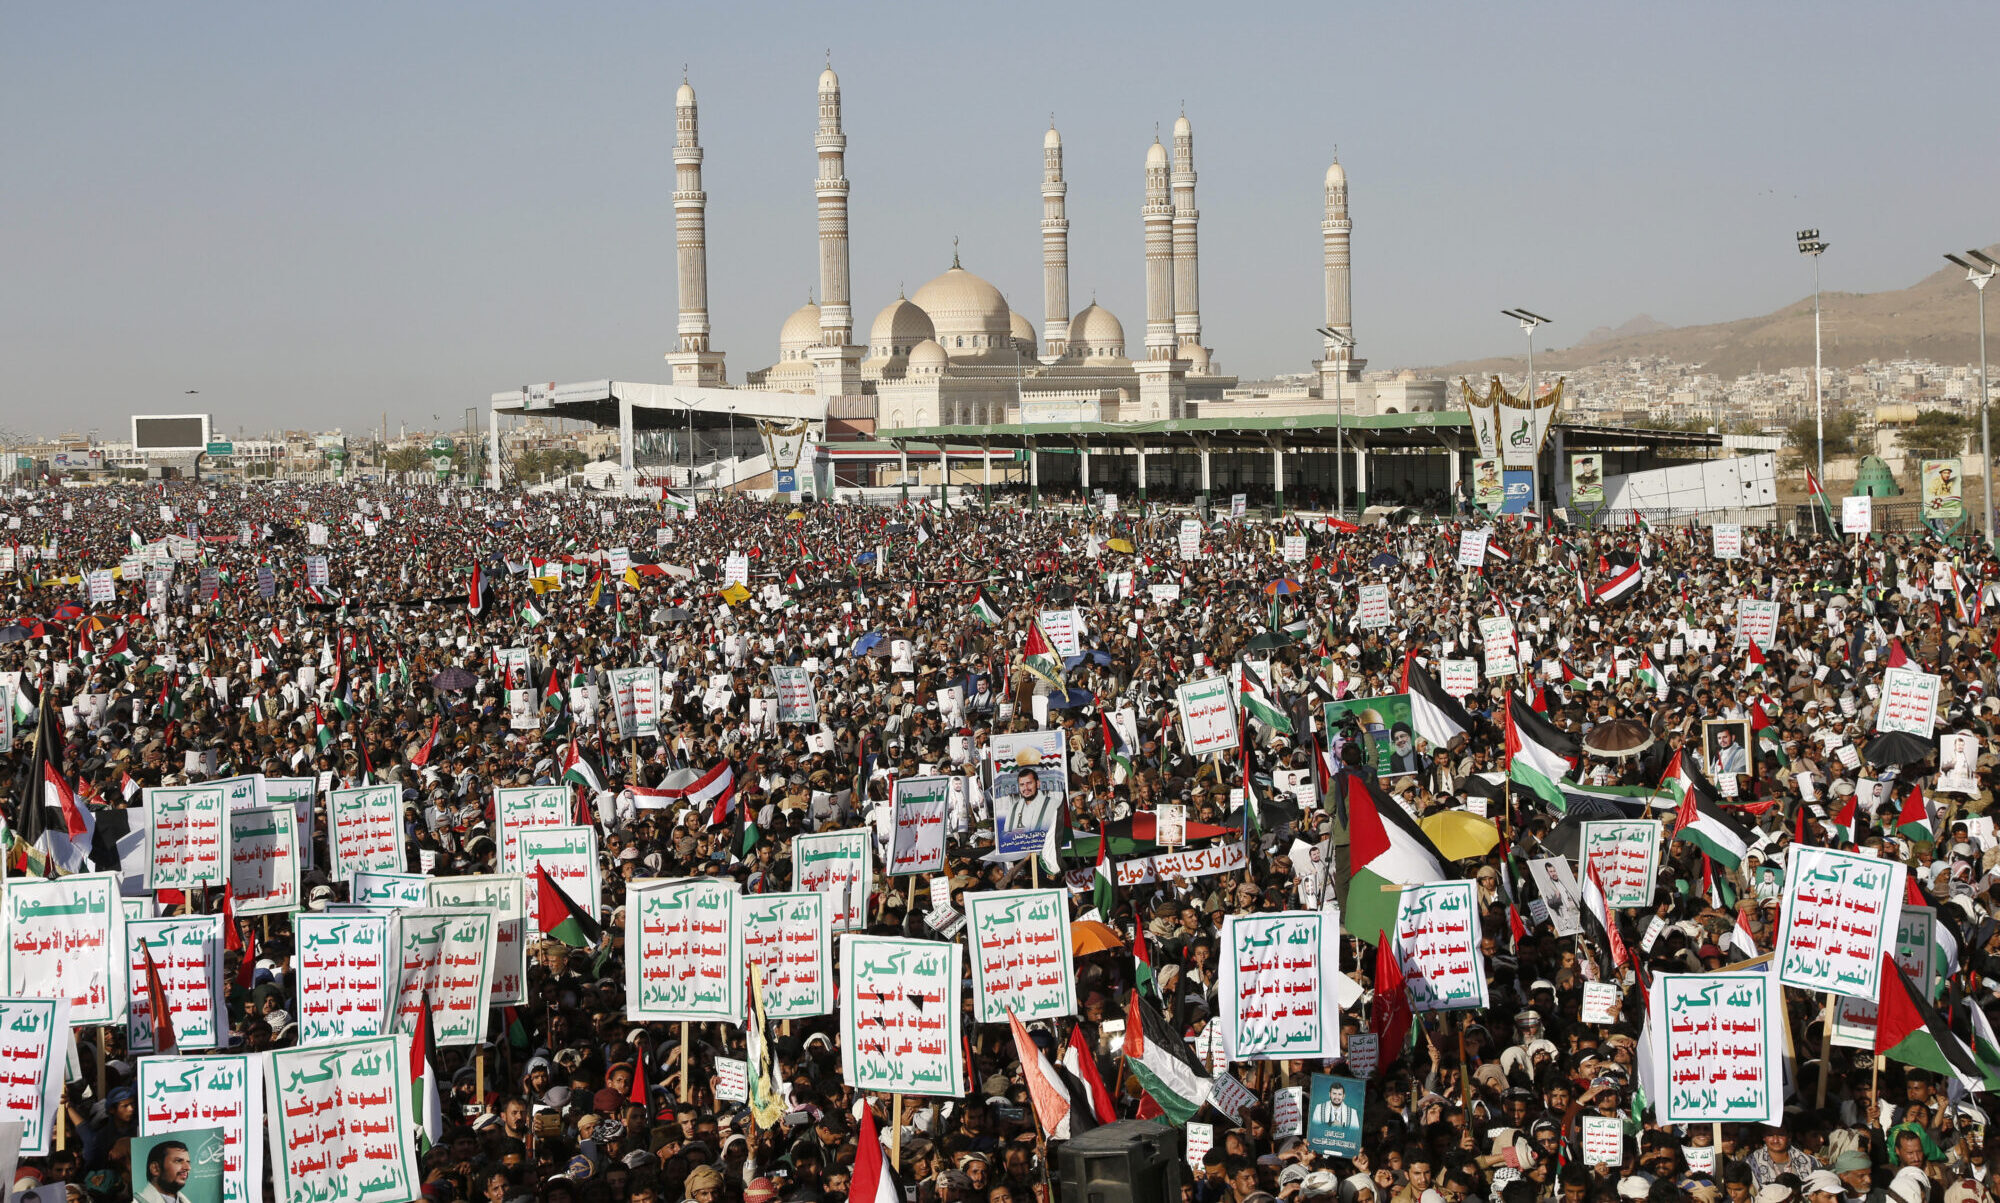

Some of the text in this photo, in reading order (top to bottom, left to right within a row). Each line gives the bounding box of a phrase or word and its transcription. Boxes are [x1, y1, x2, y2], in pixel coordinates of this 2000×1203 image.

[196, 796, 219, 810] الله
[191, 818, 218, 830] الموت
[191, 835, 218, 847] الموت
[1627, 832, 1650, 842] الله
[191, 862, 218, 884] النصر
[1853, 868, 1885, 889] الله
[697, 892, 727, 909] الله
[1440, 892, 1467, 910] الله
[1844, 900, 1881, 914] الموت
[791, 901, 817, 920] الله
[1029, 903, 1057, 920] الله
[353, 926, 381, 944] الله
[453, 924, 484, 942] الله
[691, 920, 726, 934] الموت
[1288, 924, 1316, 944] الله
[1841, 923, 1876, 937] الموت
[1025, 928, 1058, 945] الموت
[691, 943, 726, 957] الموت
[1027, 950, 1060, 967] الموت
[348, 955, 380, 970] الموت
[913, 954, 946, 976] الله
[1283, 955, 1316, 972] الموت
[349, 977, 380, 992] الموت
[1837, 966, 1871, 985] النصر
[691, 984, 725, 1006] النصر
[1283, 978, 1316, 996] الموت
[1727, 984, 1761, 1007] الله
[11, 1008, 48, 1032] الله
[351, 1018, 381, 1036] النصر
[1721, 1018, 1760, 1034] الموت
[1282, 1022, 1317, 1047] النصر
[1722, 1044, 1761, 1059] الموت
[350, 1050, 391, 1076] الله
[208, 1065, 242, 1090] الله
[909, 1061, 947, 1085] النصر
[347, 1087, 392, 1109] الموت
[1723, 1087, 1762, 1114] النصر
[202, 1101, 241, 1122] الموت
[350, 1116, 394, 1137] الموت
